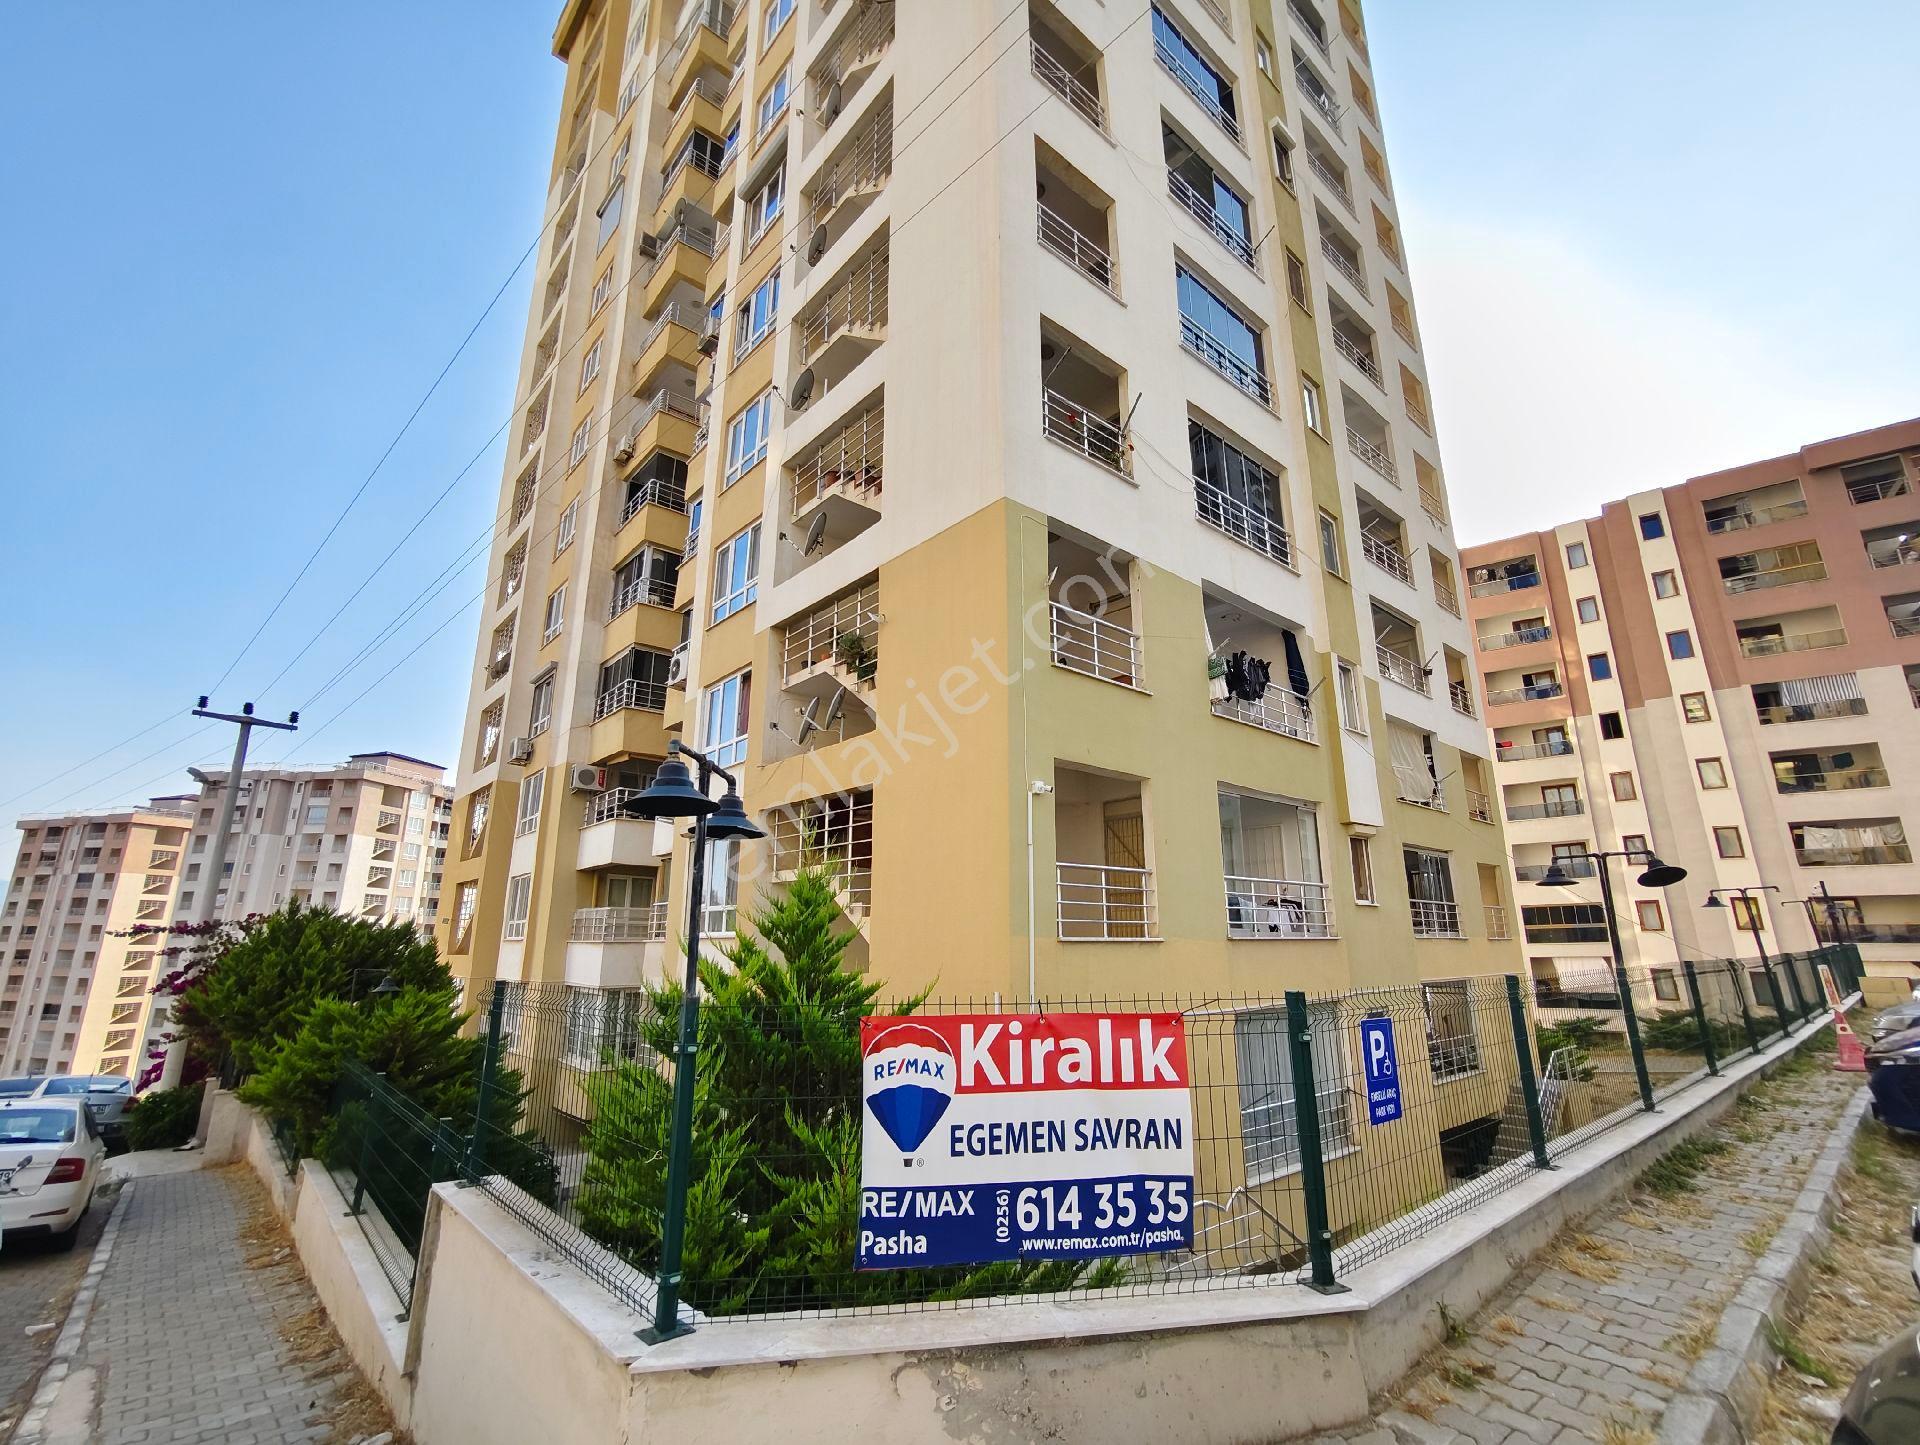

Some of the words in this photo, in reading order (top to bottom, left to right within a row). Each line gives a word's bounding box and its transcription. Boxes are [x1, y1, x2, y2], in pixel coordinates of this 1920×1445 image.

[874, 1058, 945, 1081] RE/MAX
[960, 1019, 1181, 1087] Kiralık
[1369, 1030, 1385, 1077] P
[950, 1120, 1066, 1157] EGEMEN
[1074, 1118, 1183, 1151] SAVRAN
[861, 1190, 975, 1218] RE/MAX
[996, 1189, 1011, 1243] (0256)
[1016, 1187, 1083, 1232] 614
[1094, 1183, 1137, 1229] 35
[1145, 1181, 1189, 1224] 35
[860, 1230, 927, 1255] Pasha
